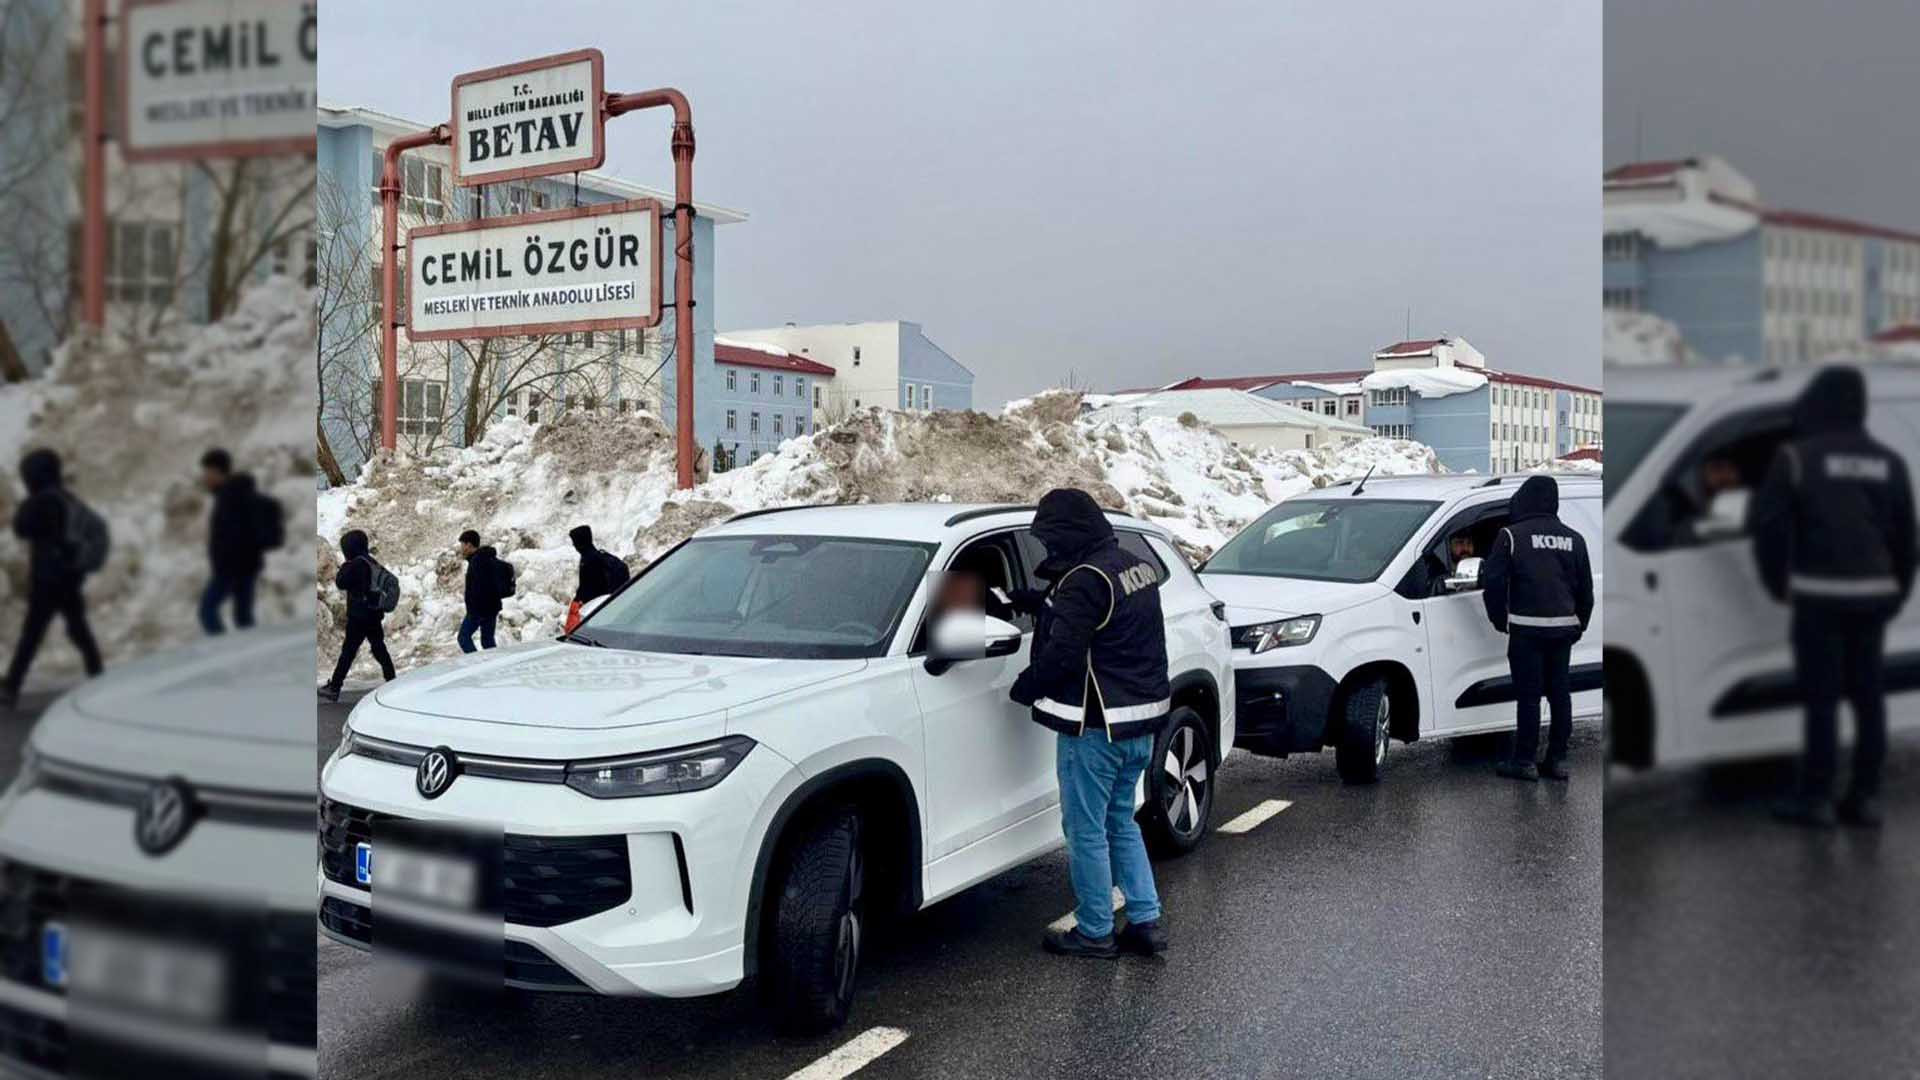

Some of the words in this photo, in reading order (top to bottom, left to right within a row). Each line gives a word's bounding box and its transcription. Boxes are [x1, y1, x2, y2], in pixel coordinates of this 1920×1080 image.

[513, 84, 533, 96] T.C.
[528, 89, 584, 110] BAKANLIĞI
[468, 112, 584, 162] BETAV
[524, 227, 639, 276] ÖZGÜR
[424, 296, 469, 315] MESLEKİ
[471, 297, 486, 312] VE
[487, 290, 530, 310] TEKNİK
[532, 288, 593, 306] ANADOLU
[596, 281, 635, 302] LİSESİ
[1531, 534, 1572, 551] KOM
